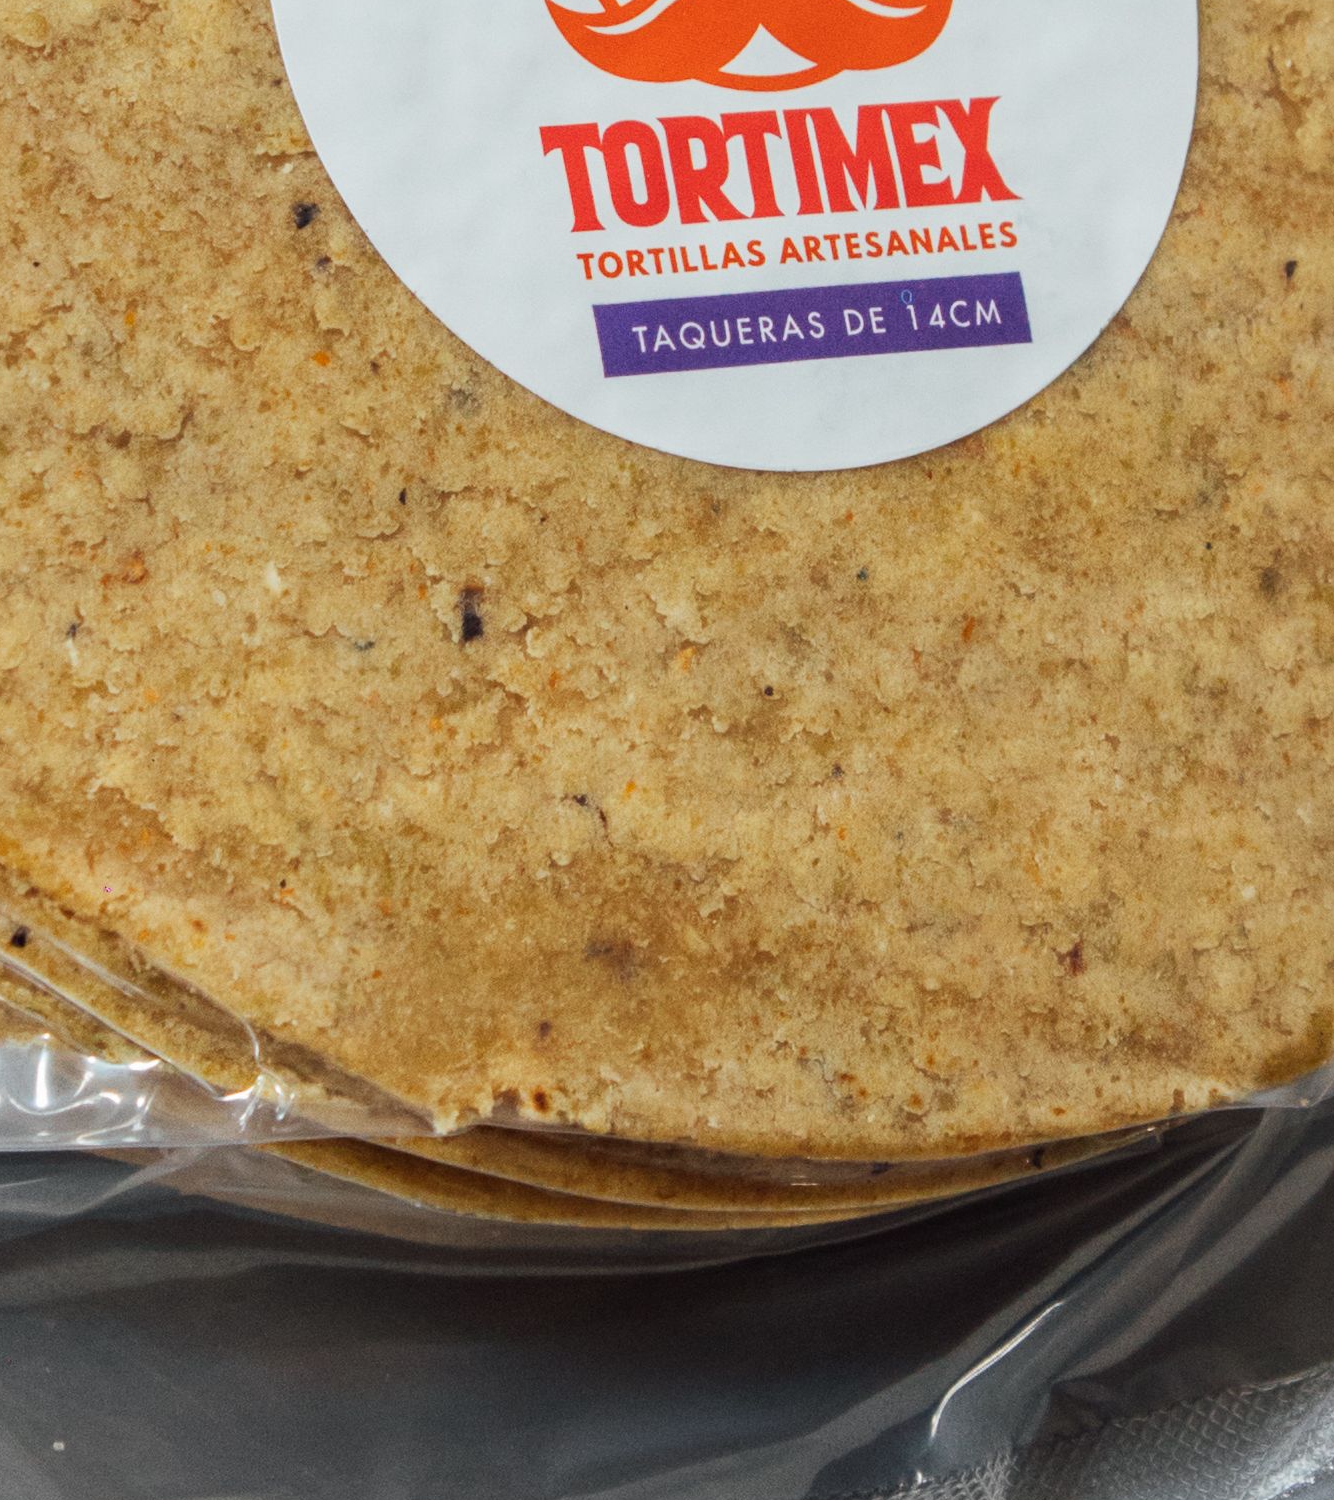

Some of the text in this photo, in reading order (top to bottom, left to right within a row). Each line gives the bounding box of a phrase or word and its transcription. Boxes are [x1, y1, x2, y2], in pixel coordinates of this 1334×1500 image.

[538, 96, 1024, 233] TORTIMEX
[575, 220, 1018, 281] TORTILLAS ARTESANALES
[631, 299, 1002, 353] TAQUERAS DE 14CM
